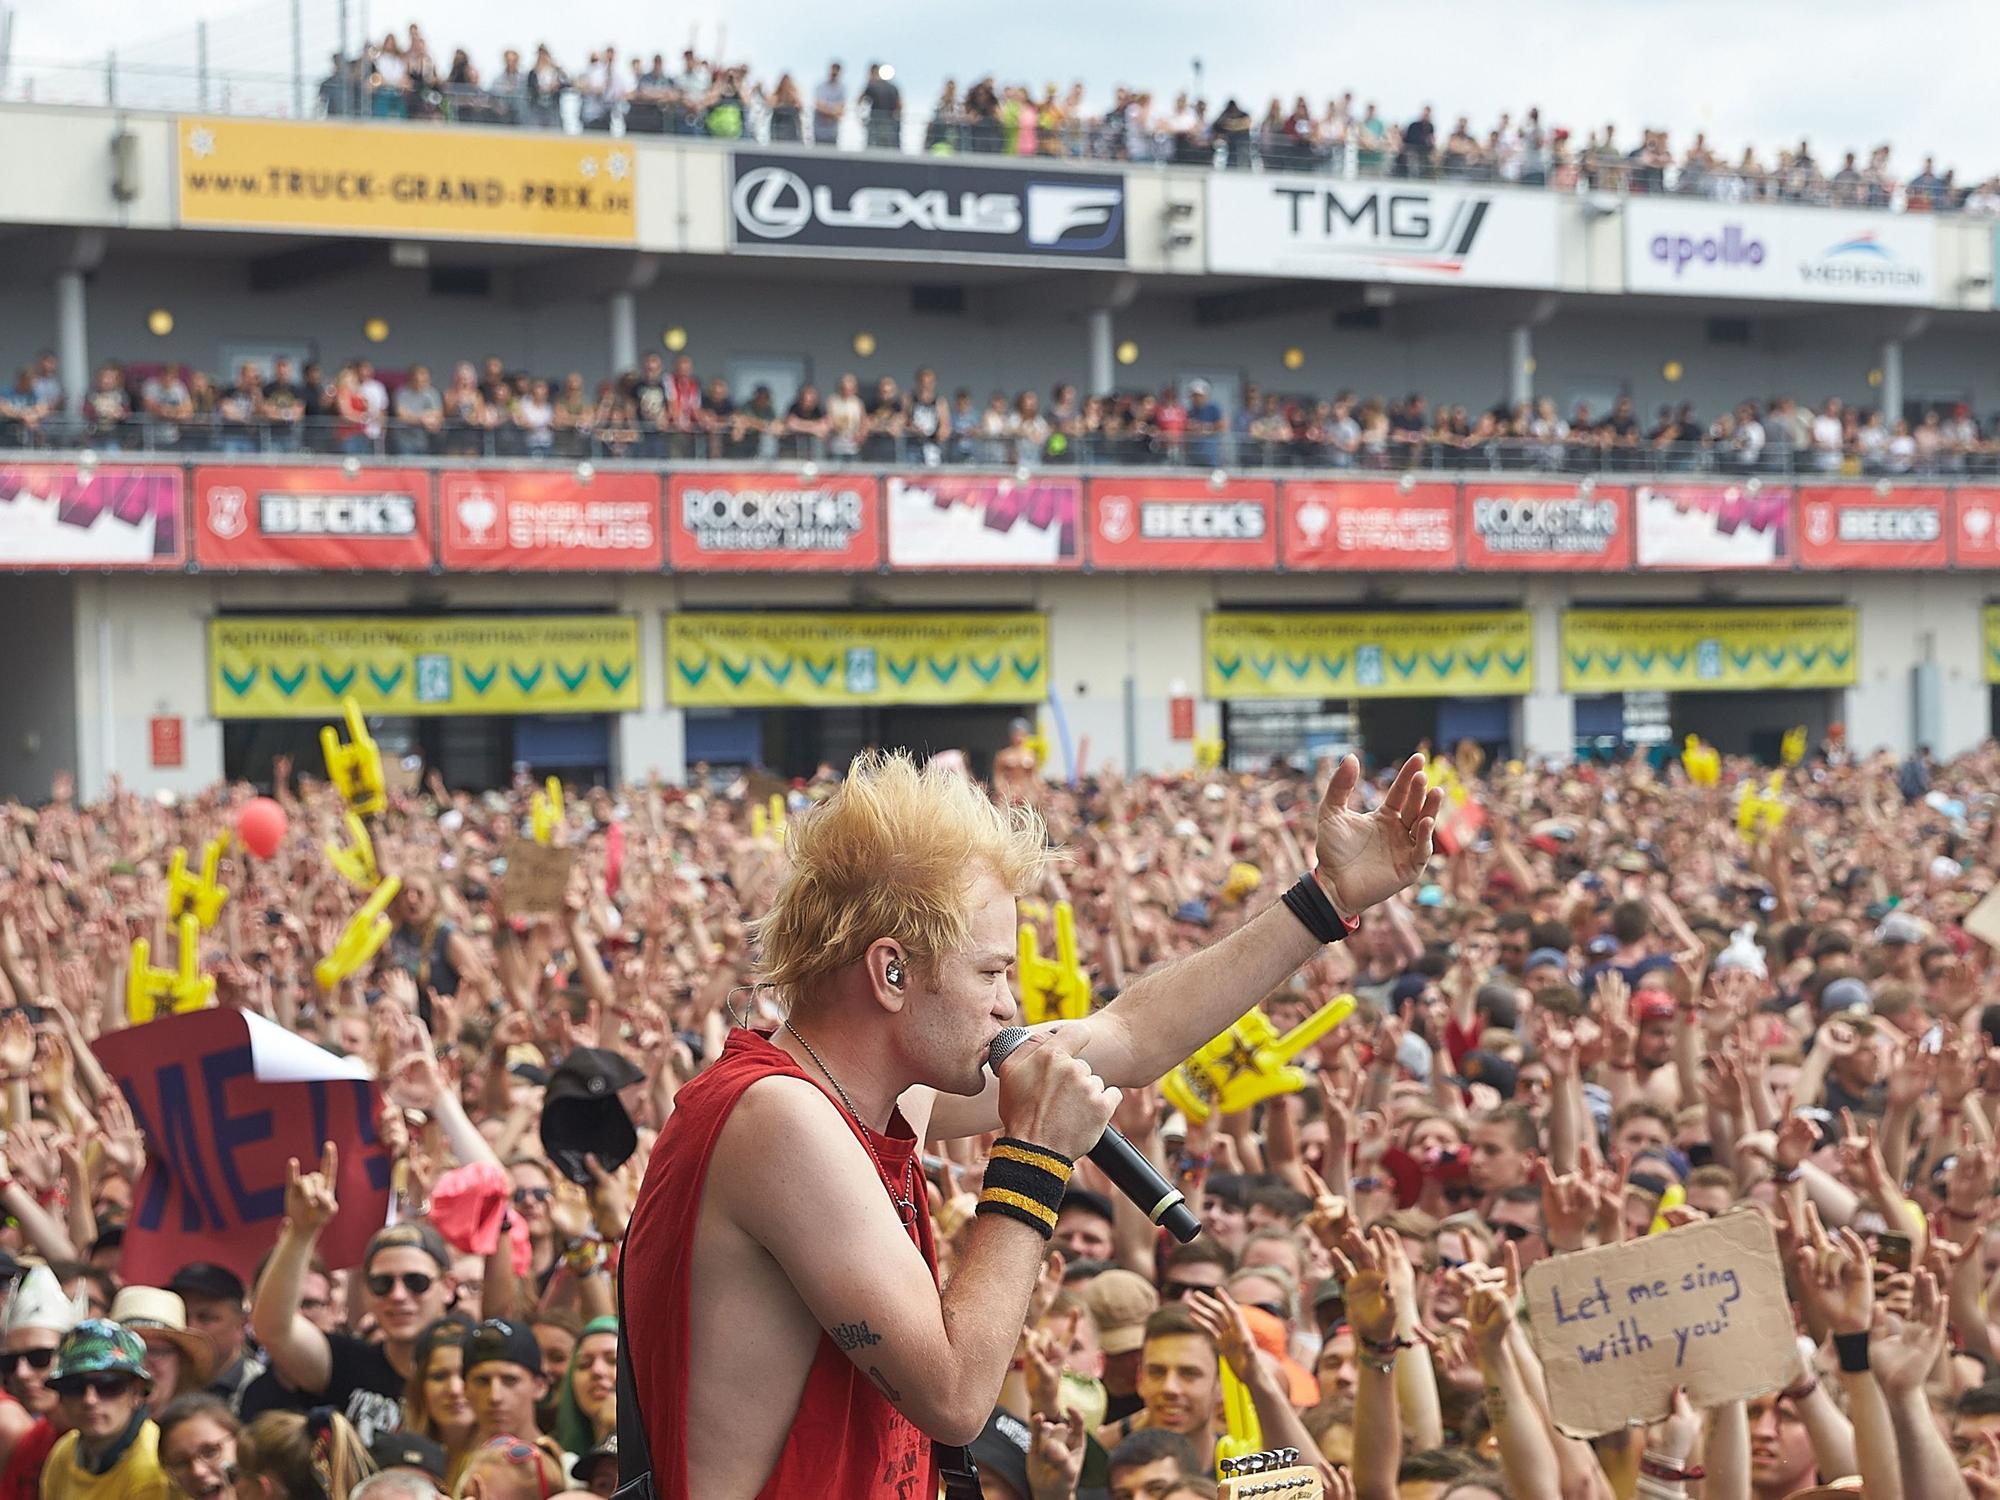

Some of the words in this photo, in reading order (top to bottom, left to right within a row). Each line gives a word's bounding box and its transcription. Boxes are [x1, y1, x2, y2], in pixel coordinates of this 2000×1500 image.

[814, 185, 1022, 234] LEXUS
[1274, 188, 1430, 238] TMG
[1653, 227, 1764, 274] apollo
[1552, 1277, 1610, 1325] Let
[1627, 1279, 1668, 1303] me
[1681, 1263, 1741, 1301] sing
[1577, 1317, 1653, 1364] with
